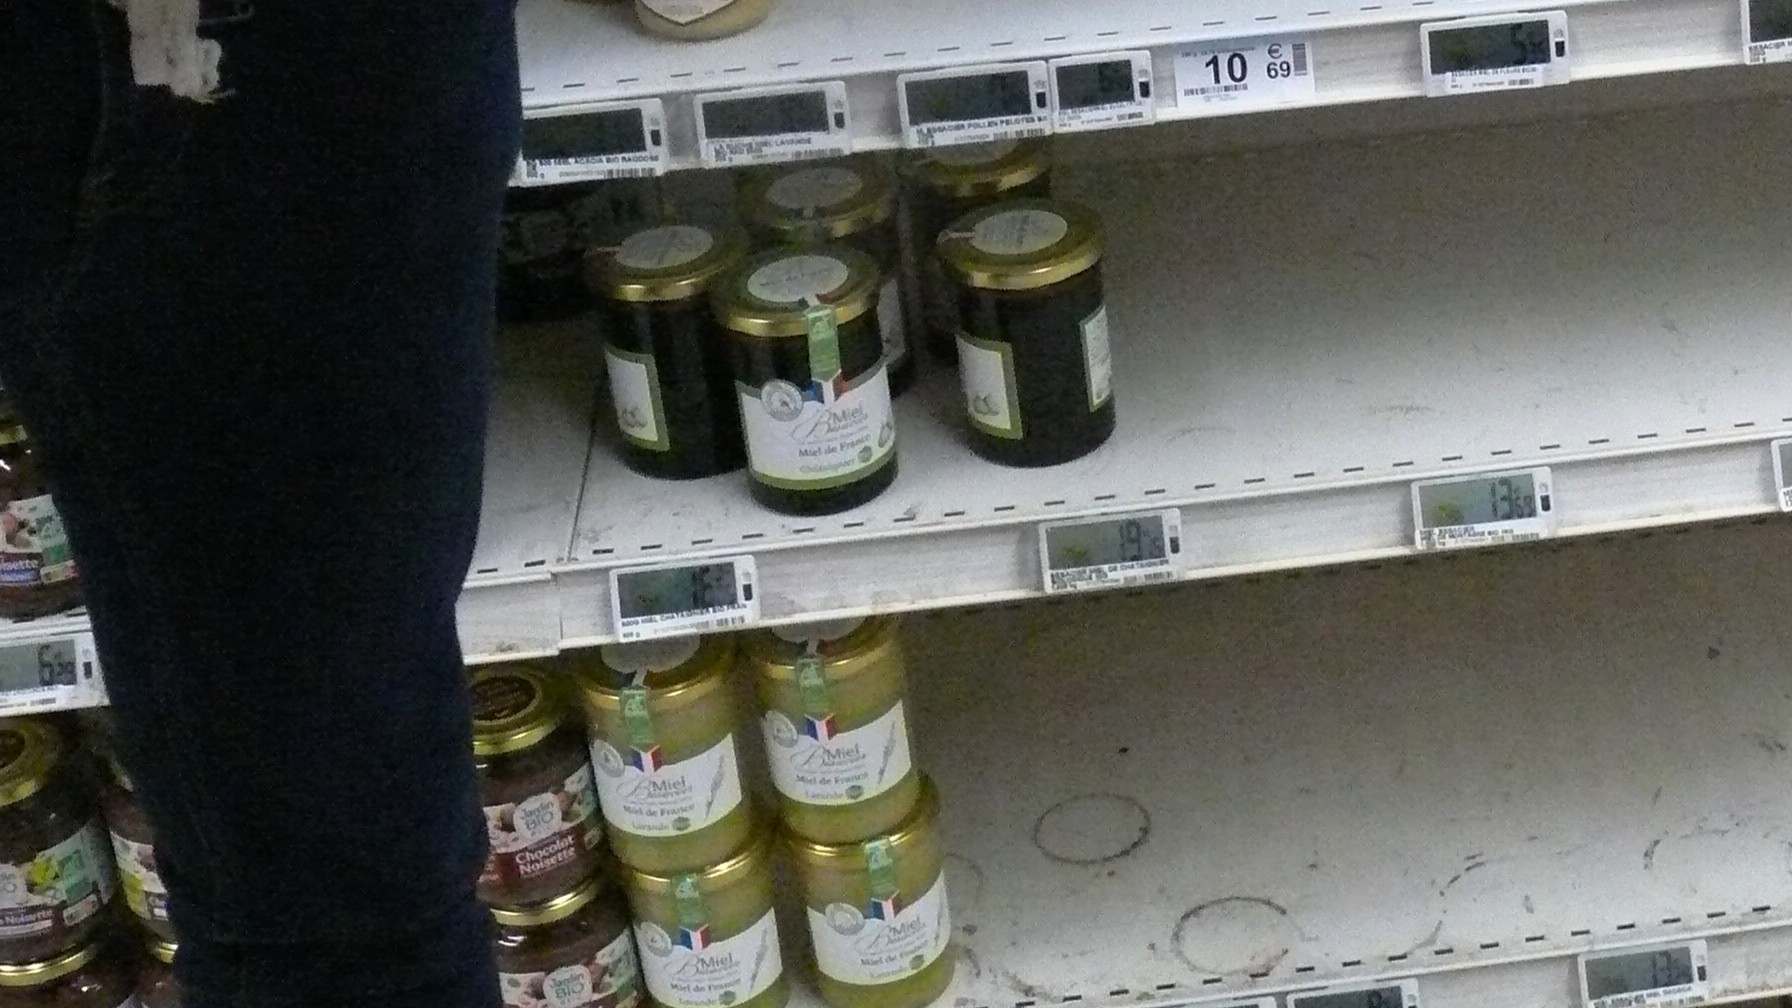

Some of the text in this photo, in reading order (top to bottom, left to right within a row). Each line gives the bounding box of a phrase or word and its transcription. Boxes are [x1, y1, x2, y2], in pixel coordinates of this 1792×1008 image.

[1205, 52, 1247, 85] 10
[1266, 60, 1291, 79] 69
[832, 401, 863, 422] Miel
[798, 434, 871, 458] Miel de France
[826, 743, 860, 760] Miel
[652, 775, 687, 792] Miel
[796, 774, 817, 785] Miel
[819, 775, 833, 785] de
[520, 800, 555, 821] Jardin
[525, 811, 554, 831] BIO
[515, 834, 576, 865] Chocolat
[519, 846, 576, 876] Noisette
[701, 952, 733, 969] Miel
[550, 972, 584, 990] Jardin
[555, 982, 584, 1001] BIO
